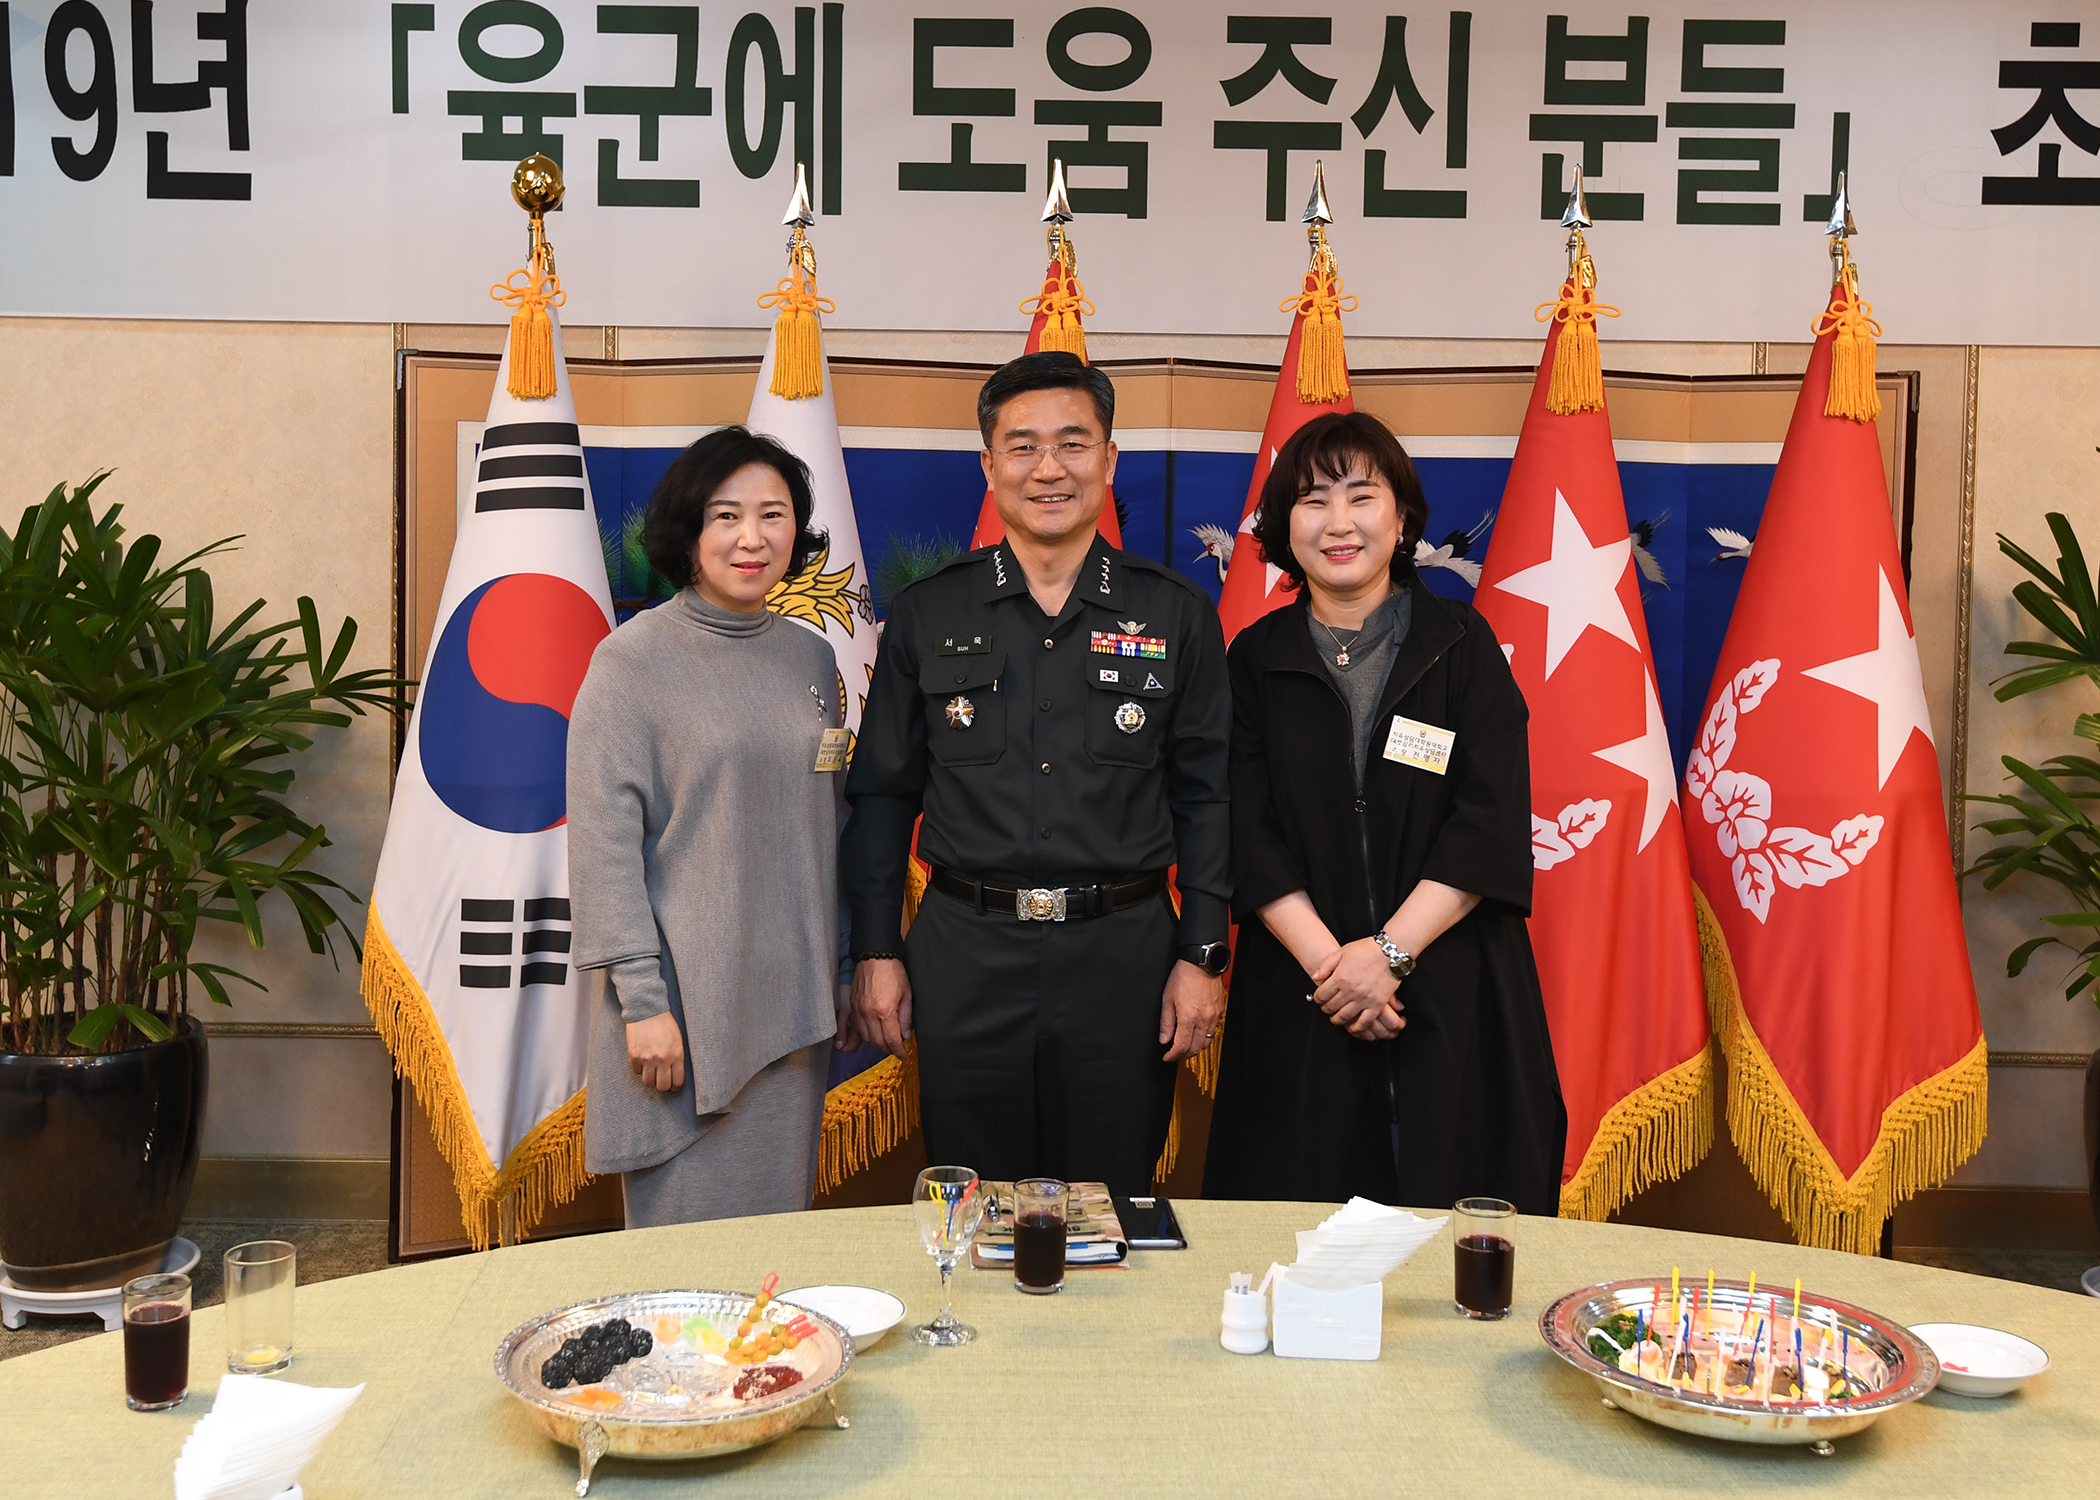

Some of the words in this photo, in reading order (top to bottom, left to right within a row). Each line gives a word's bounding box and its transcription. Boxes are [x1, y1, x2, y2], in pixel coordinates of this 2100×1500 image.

[899, 7, 1163, 220] 도움
[1213, 11, 1472, 221] 주신
[944, 638, 953, 647] 서
[974, 636, 982, 645] 욱
